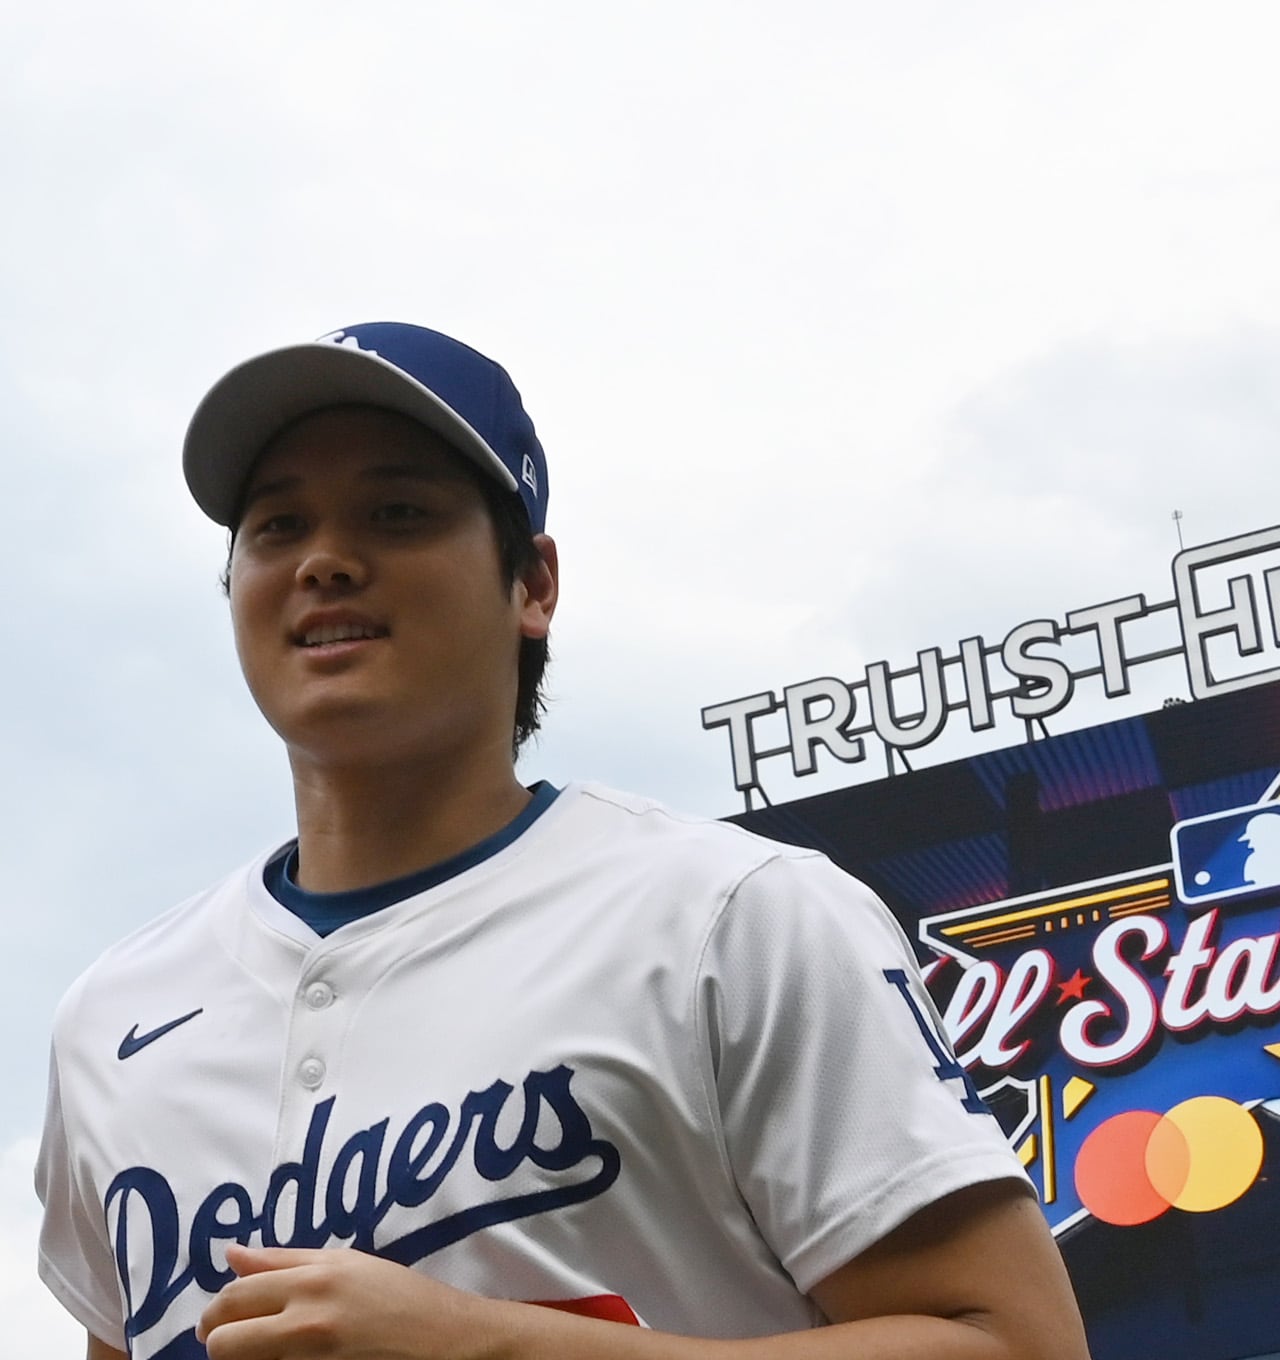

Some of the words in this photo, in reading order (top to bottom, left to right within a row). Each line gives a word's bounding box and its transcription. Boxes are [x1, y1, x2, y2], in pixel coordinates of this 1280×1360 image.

[702, 593, 1147, 788] TRUIST
[920, 948, 1055, 1070] ll
[105, 1063, 610, 1345] Dodgers
